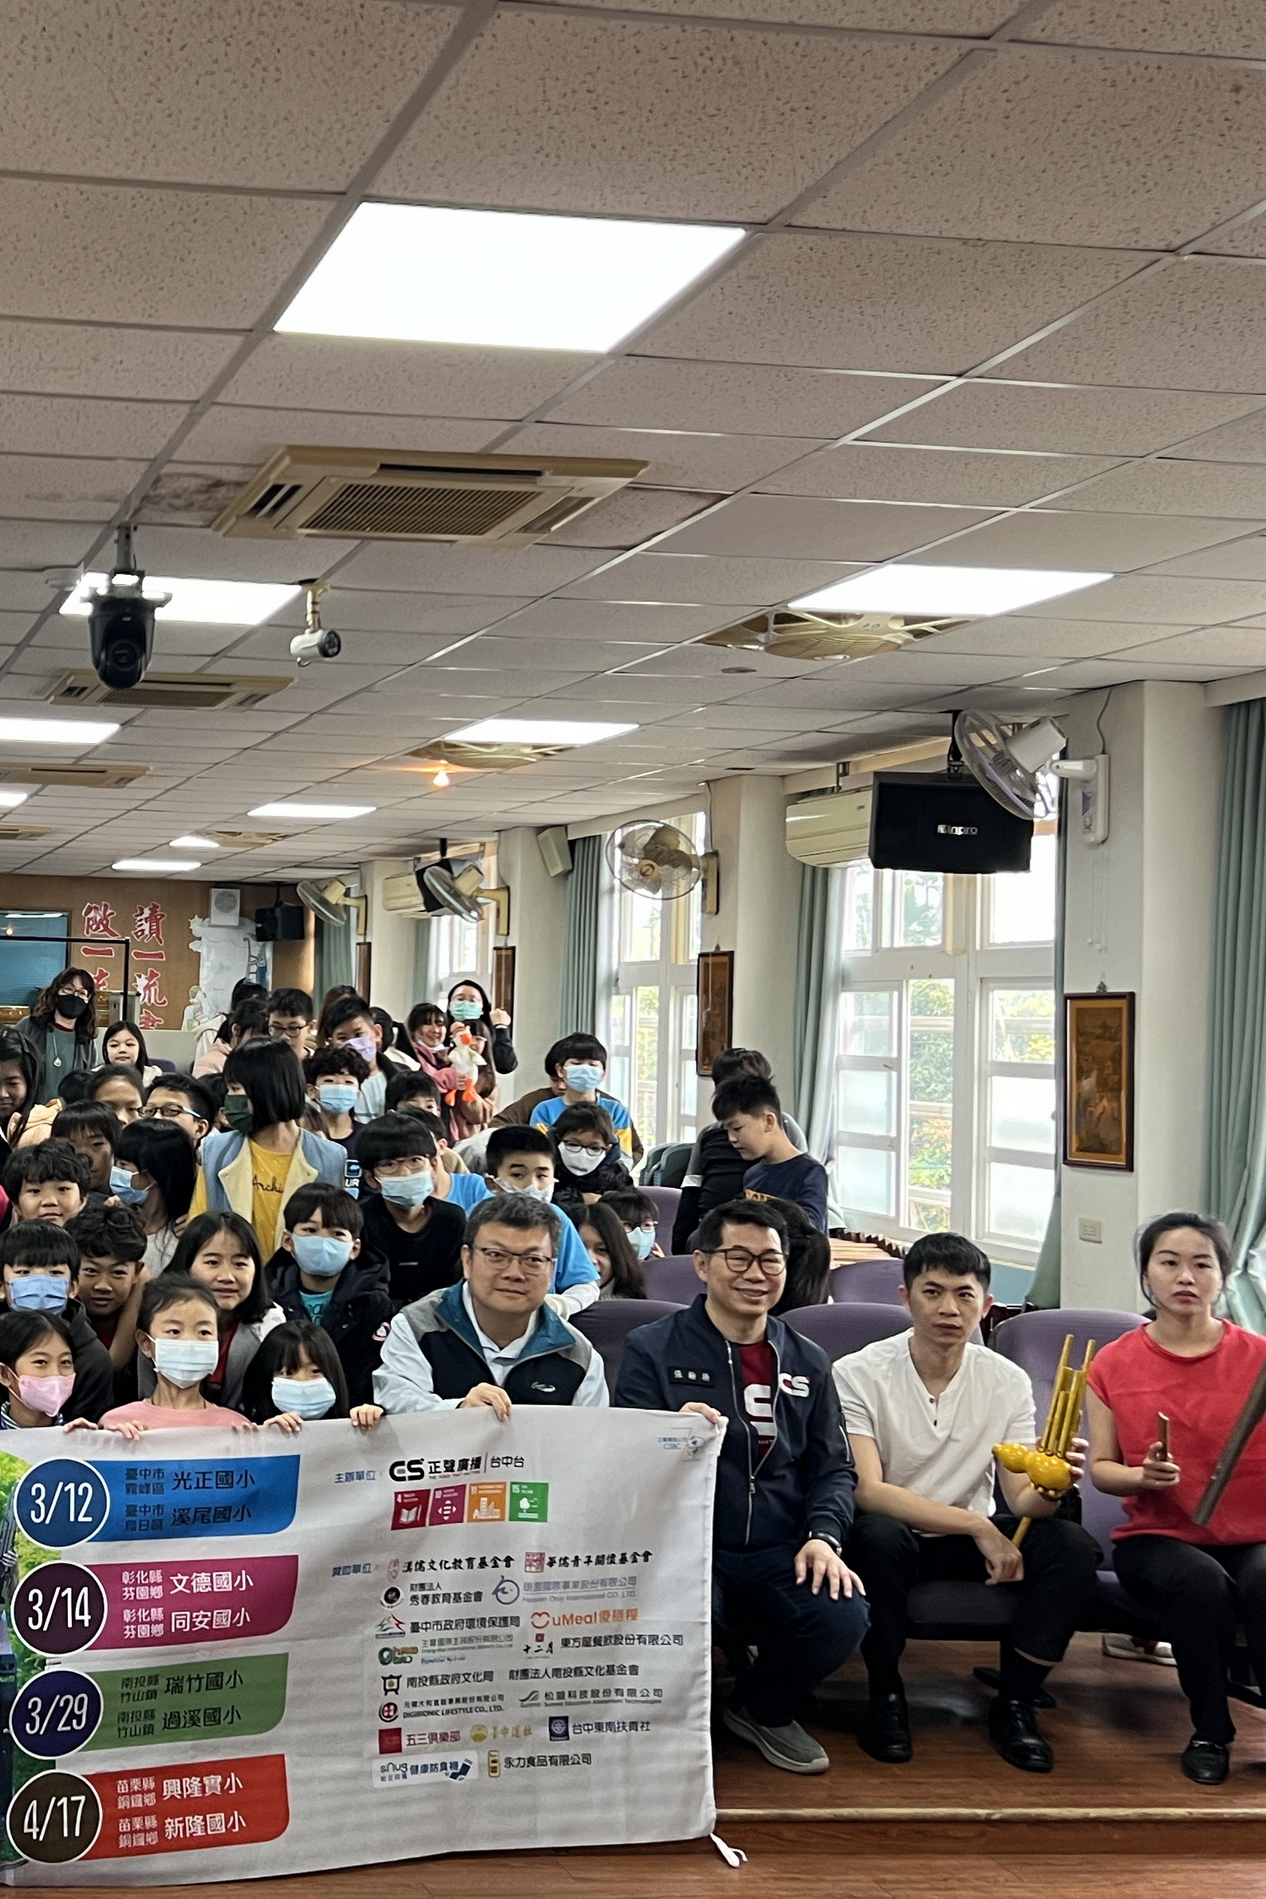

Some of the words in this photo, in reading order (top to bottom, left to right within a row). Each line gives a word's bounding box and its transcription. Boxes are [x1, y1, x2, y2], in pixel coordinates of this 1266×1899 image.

[778, 1372, 811, 1398] CS
[125, 1467, 166, 1480] 臺中市
[389, 1458, 426, 1482] CS
[428, 1456, 482, 1475] 正聲廣播
[490, 1455, 525, 1469] 台中台
[171, 1469, 256, 1490] 光正國小
[30, 1481, 94, 1525] 3/12
[125, 1504, 166, 1517] 臺中市
[170, 1503, 252, 1527] 溪尾國小
[546, 1550, 653, 1568] 華儒青年關懷基金會
[122, 1569, 163, 1585] 彰化縣
[169, 1569, 254, 1595] 文德國小
[122, 1585, 164, 1601] 芬園鄉
[27, 1586, 92, 1632] 3/14
[123, 1607, 164, 1623] 彰化縣
[170, 1607, 251, 1633] 同安國小
[410, 1616, 521, 1634] 臺中市政府環境保護局
[123, 1624, 164, 1640] 芬園鄉
[406, 1670, 494, 1689] 南投縣政府文化局
[508, 1664, 640, 1681] 財團法人南投縣文化基金會
[121, 1674, 160, 1690] 南投縣
[164, 1669, 244, 1695] 瑞竹國小
[120, 1689, 158, 1704] 竹山鎮
[25, 1693, 89, 1736] 3/29
[117, 1708, 156, 1724] 南投縣
[162, 1705, 241, 1731] 過溪國小
[441, 1706, 473, 1716] LIFESTYLE
[117, 1724, 155, 1739] 竹山鎮
[406, 1730, 461, 1747] 五三俱樂部
[116, 1776, 156, 1793] 苗栗縣
[23, 1795, 86, 1842] 4/17
[118, 1815, 158, 1832] 苗栗縣
[164, 1810, 247, 1840] 新隆國小
